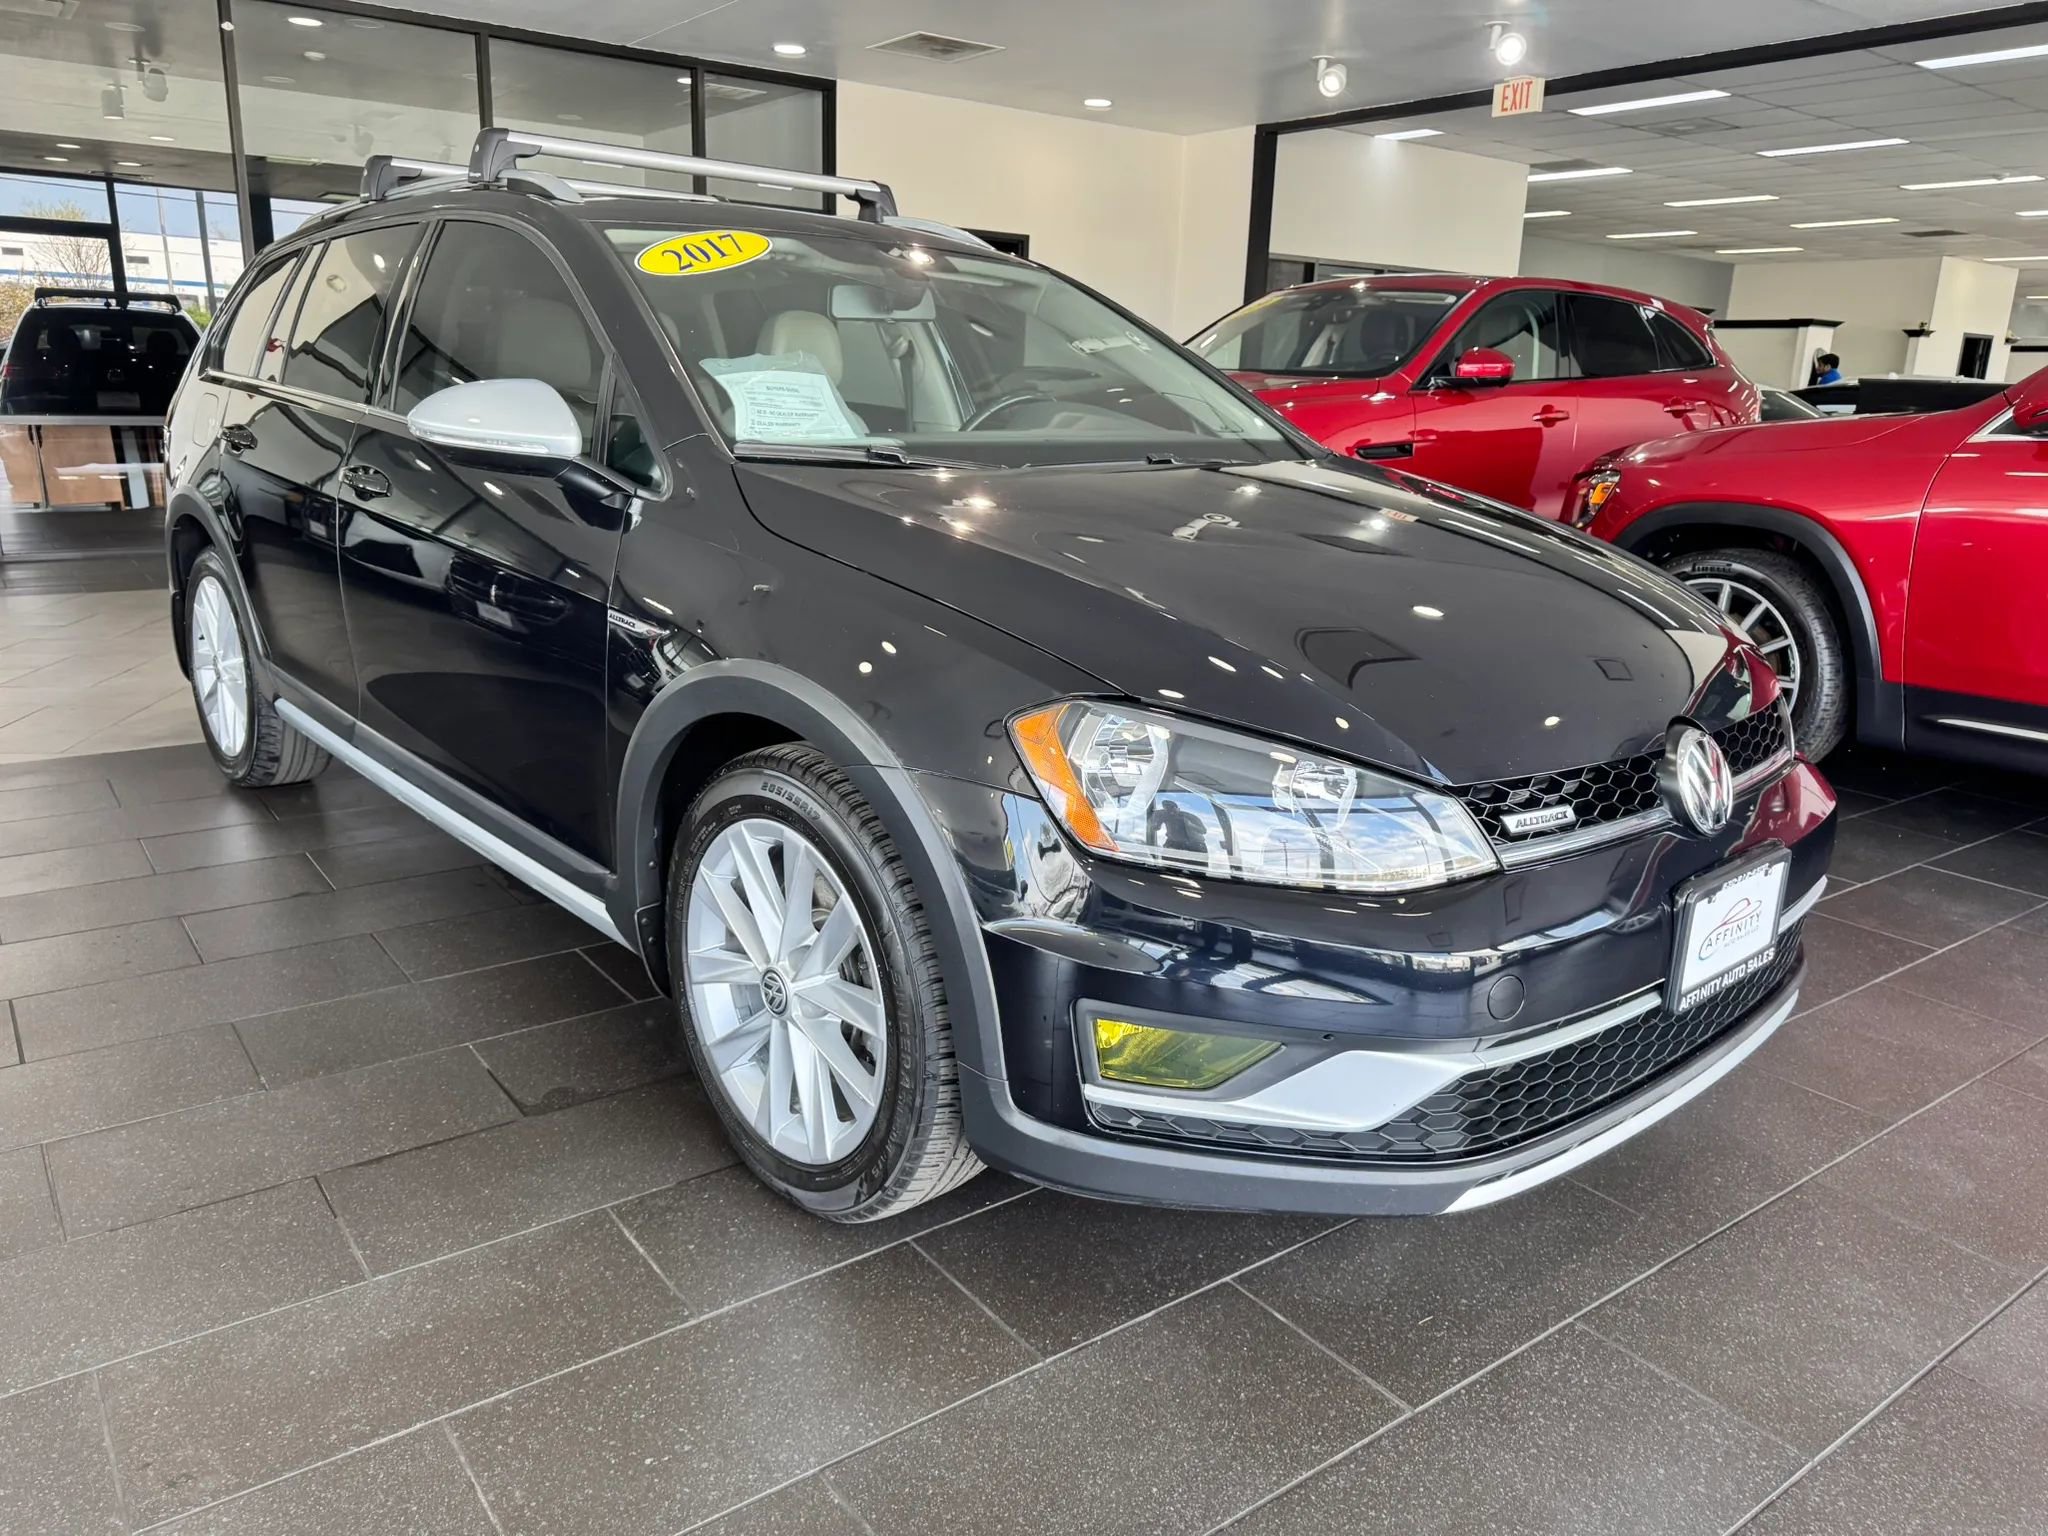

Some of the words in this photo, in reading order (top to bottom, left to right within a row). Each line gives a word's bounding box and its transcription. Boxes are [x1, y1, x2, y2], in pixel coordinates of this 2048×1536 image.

[1501, 80, 1534, 113] EXIT
[661, 233, 743, 272] 2017
[609, 613, 636, 629] ALLTRACK
[1515, 810, 1568, 829] ALLTRACK
[1705, 911, 1763, 951] AFFINITY
[1679, 976, 1722, 1012] AFFINITY
[1722, 963, 1746, 988] AUTO
[1747, 947, 1775, 973] SALES
